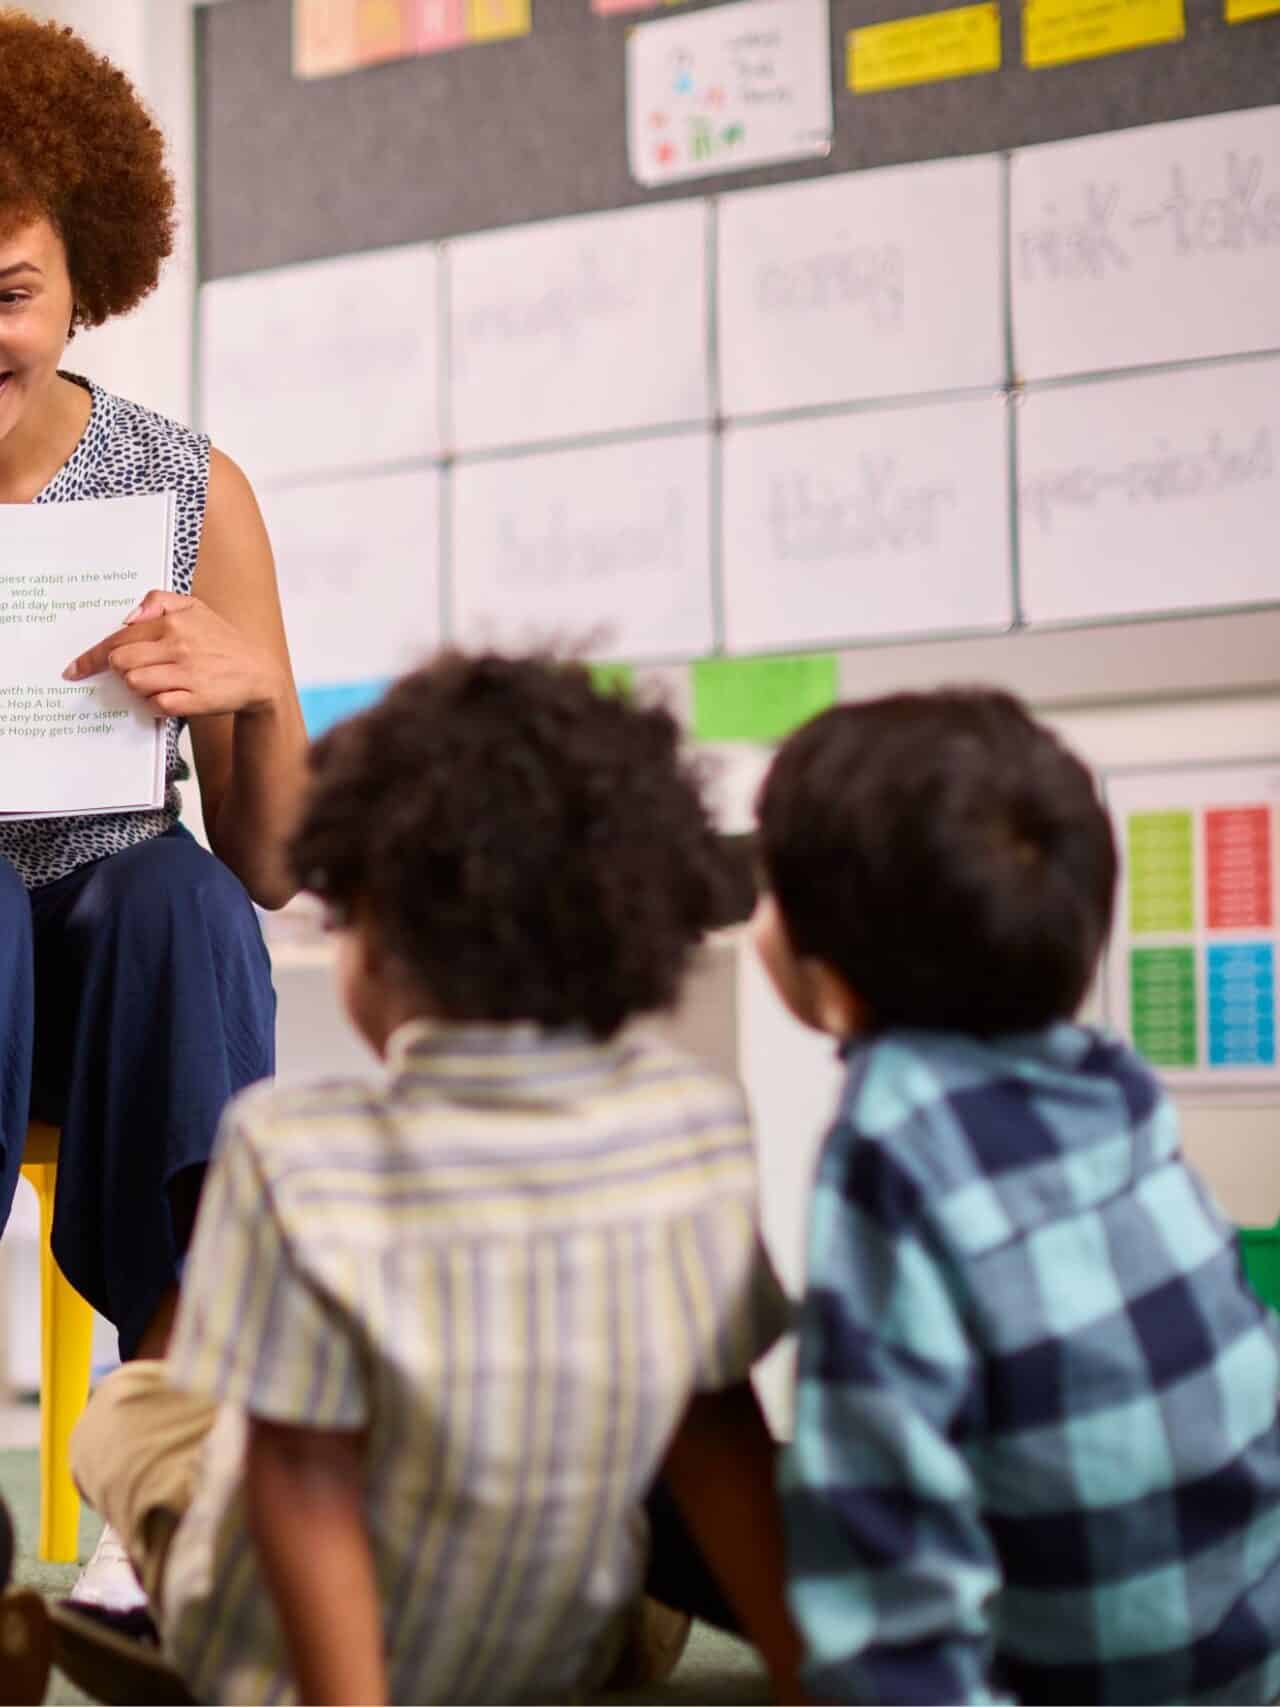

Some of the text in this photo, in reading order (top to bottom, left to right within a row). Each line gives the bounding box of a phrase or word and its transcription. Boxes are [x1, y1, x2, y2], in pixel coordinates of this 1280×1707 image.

[29, 574, 64, 584] rabbit
[67, 574, 79, 584] in
[81, 571, 100, 582] the
[103, 569, 137, 581] whole
[10, 586, 48, 597] world.
[11, 599, 25, 610] all
[28, 599, 48, 613] day
[51, 599, 77, 613] long
[79, 597, 101, 609] and
[103, 597, 135, 608] never
[26, 612, 57, 624] tired!
[0, 685, 24, 696] with
[27, 685, 44, 696] his
[7, 699, 32, 712] Hop
[9, 713, 31, 724] any
[33, 711, 77, 722] brother
[94, 708, 129, 720] sisters
[8, 726, 47, 740] Hoppy
[49, 726, 74, 739] gets
